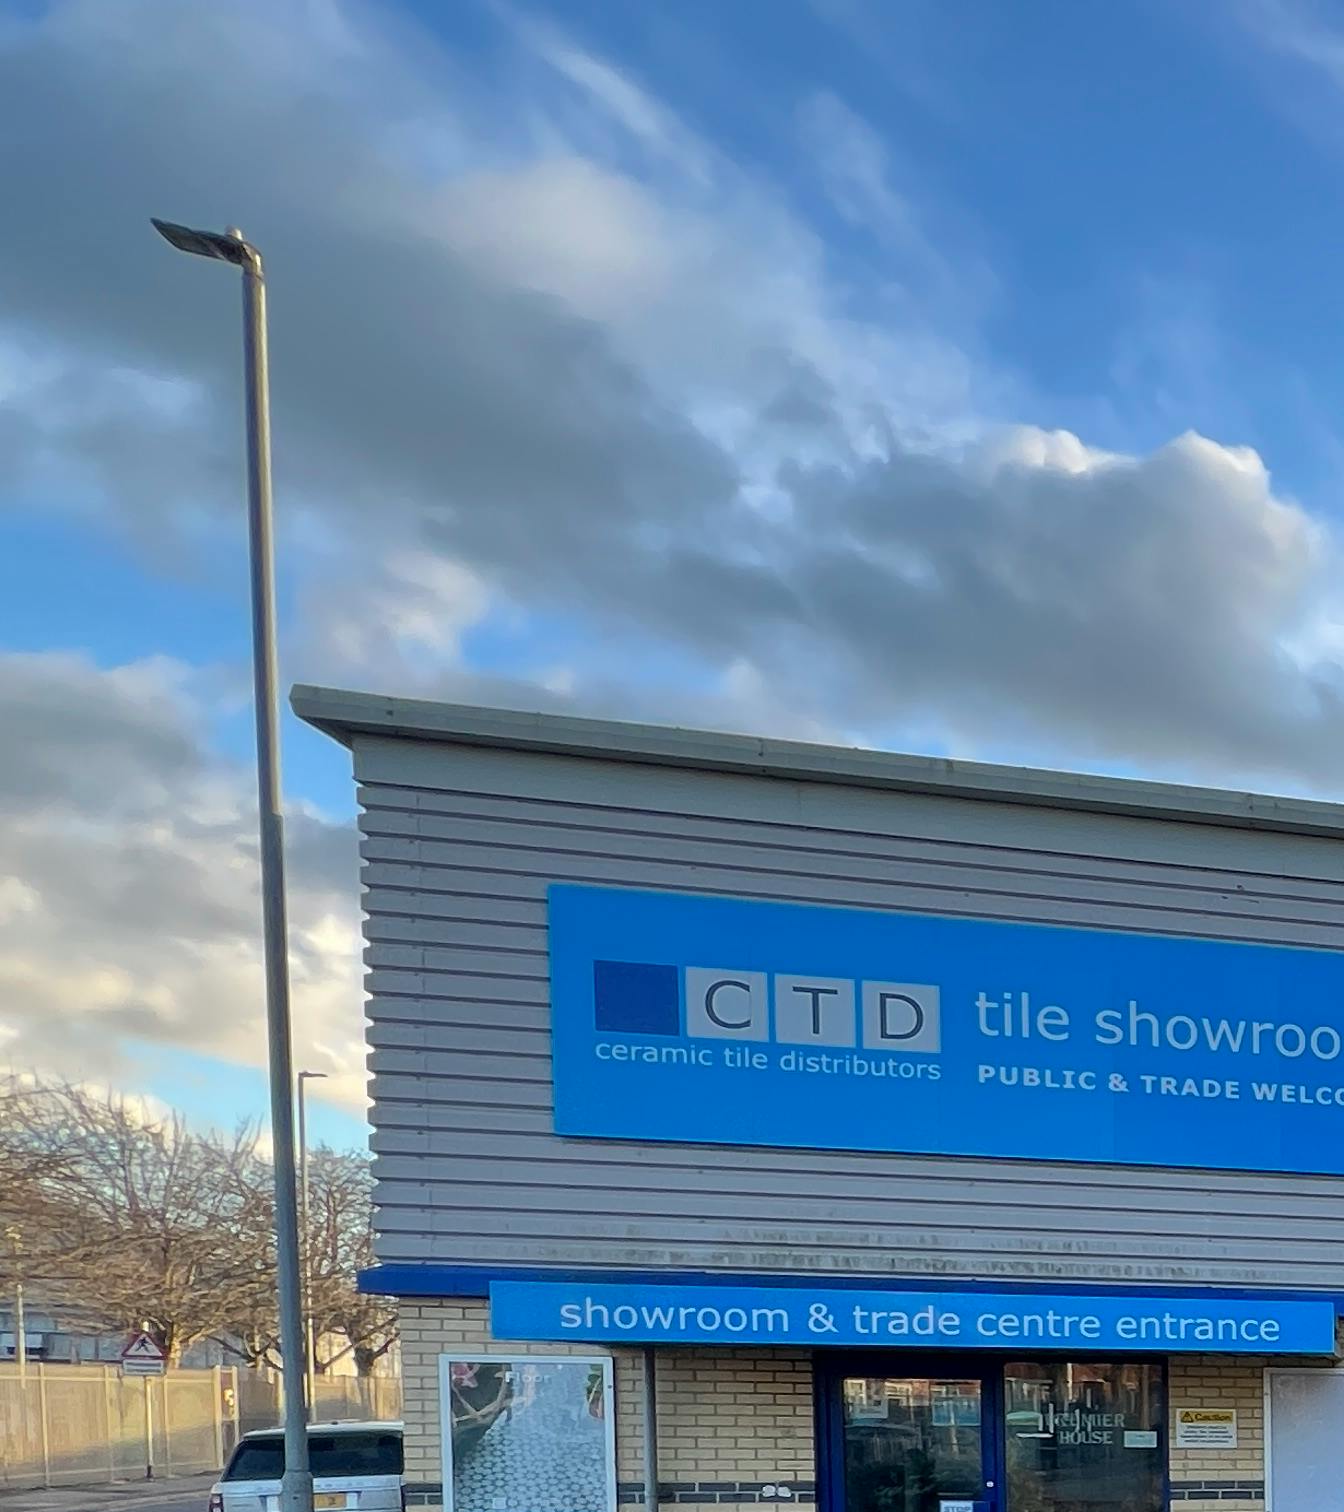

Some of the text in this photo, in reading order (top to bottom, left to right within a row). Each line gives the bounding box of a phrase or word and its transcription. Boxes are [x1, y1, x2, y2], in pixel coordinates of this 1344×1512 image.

[704, 979, 925, 1041] CTD
[975, 991, 1071, 1041] tile
[595, 1042, 942, 1081] ceramic tile distributors
[978, 1064, 1096, 1090] PUBLIC
[1107, 1072, 1130, 1093] &
[1140, 1075, 1241, 1099] TRADE
[560, 1296, 1280, 1342] showroom & trade centre entrance
[1059, 1430, 1113, 1445] HOUSE
